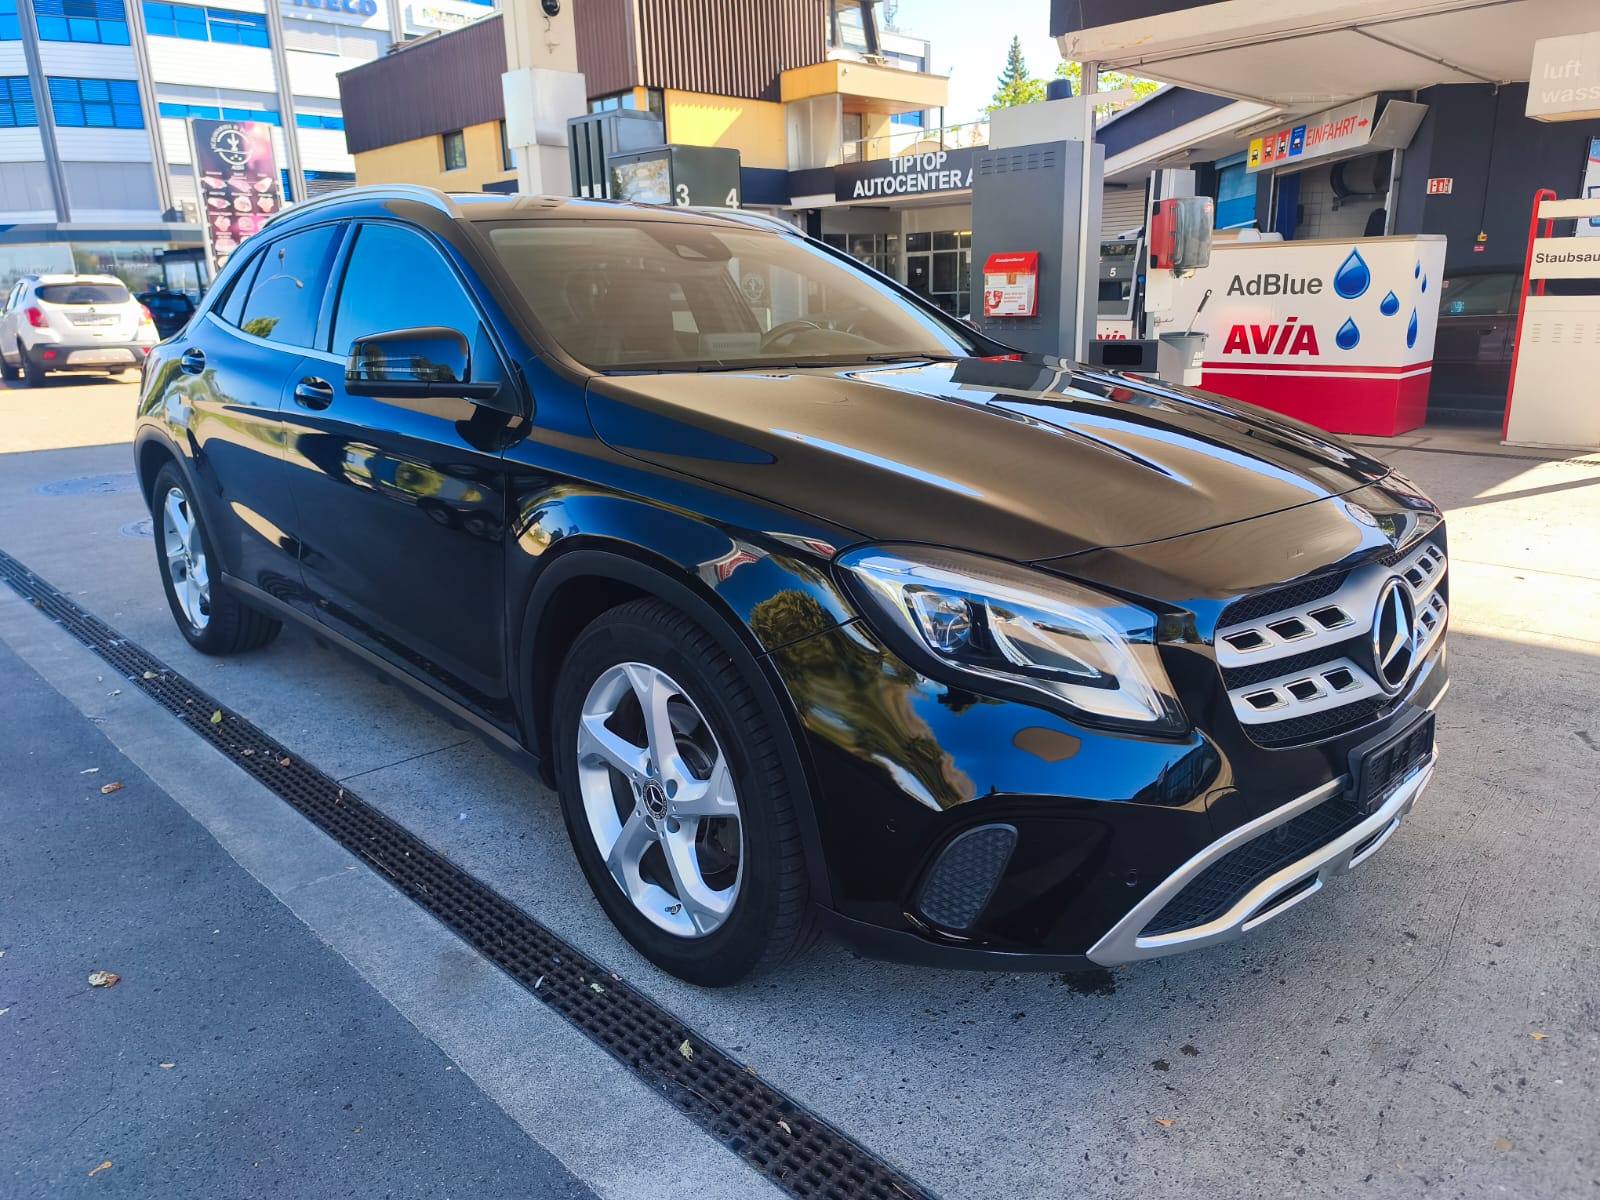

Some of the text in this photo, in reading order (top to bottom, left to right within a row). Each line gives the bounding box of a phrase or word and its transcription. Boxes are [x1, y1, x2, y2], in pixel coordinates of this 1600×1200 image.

[1543, 59, 1582, 80] luft
[1305, 115, 1358, 147] EINFAHRT
[889, 151, 948, 174] TIPTOP
[676, 183, 691, 206] 3
[853, 169, 963, 198] AUTOCENTER
[725, 188, 740, 209] 4
[1535, 251, 1600, 264] Staubsau
[1109, 267, 1117, 276] 5
[1226, 273, 1323, 297] AdBlue
